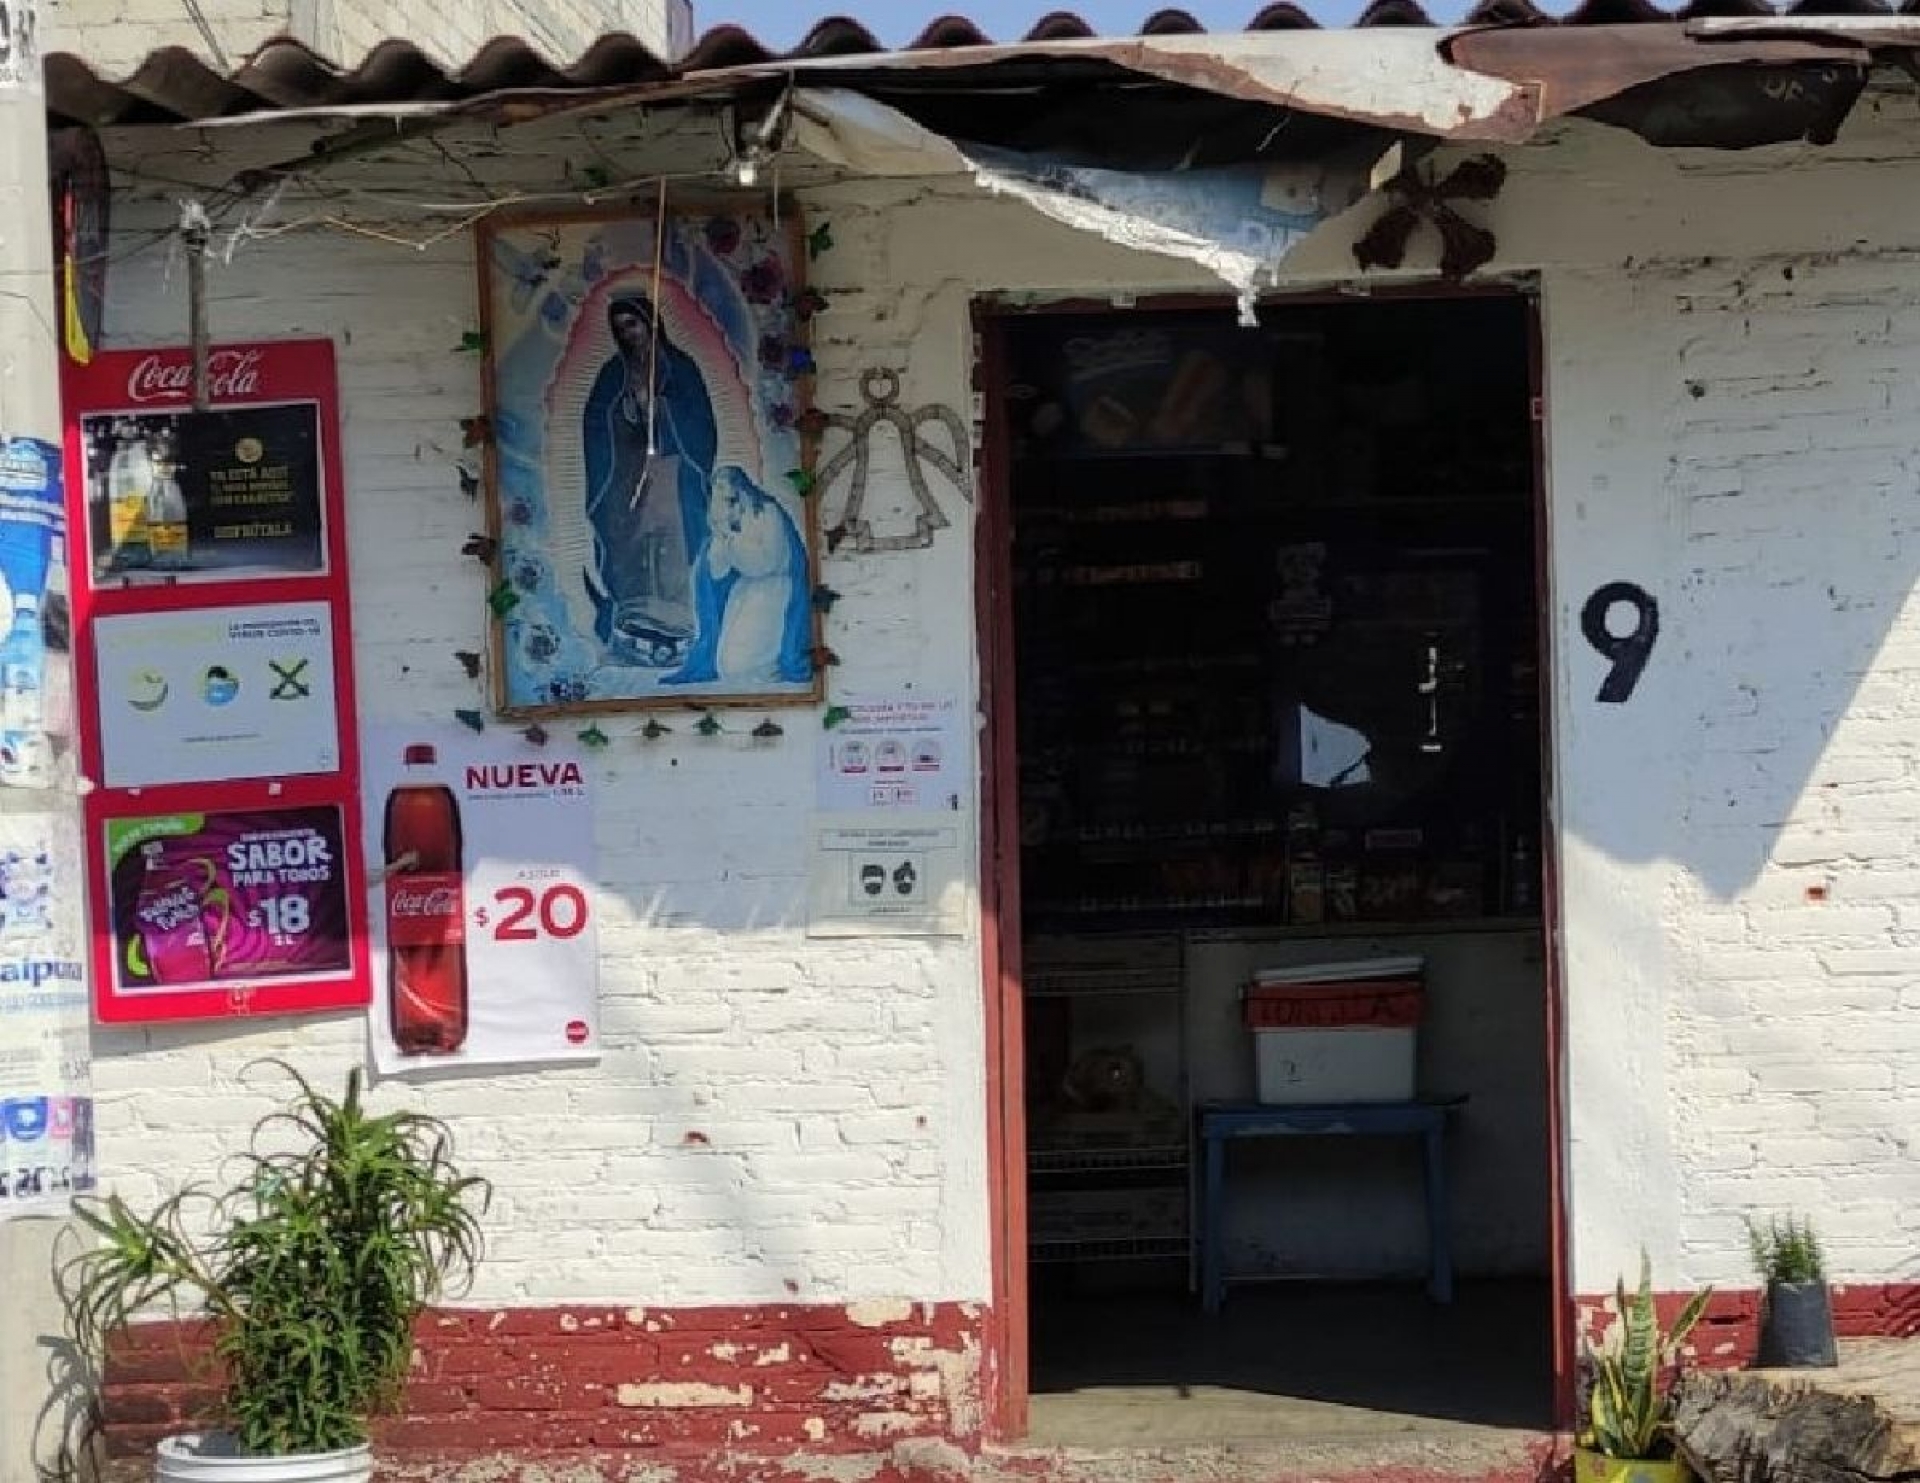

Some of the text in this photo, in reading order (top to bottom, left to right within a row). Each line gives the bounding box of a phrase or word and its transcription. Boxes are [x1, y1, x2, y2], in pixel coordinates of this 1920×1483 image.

[1580, 581, 1660, 702] 9
[466, 763, 584, 789] NUEVA
[228, 836, 333, 871] SABOR
[279, 864, 331, 883] TODOS
